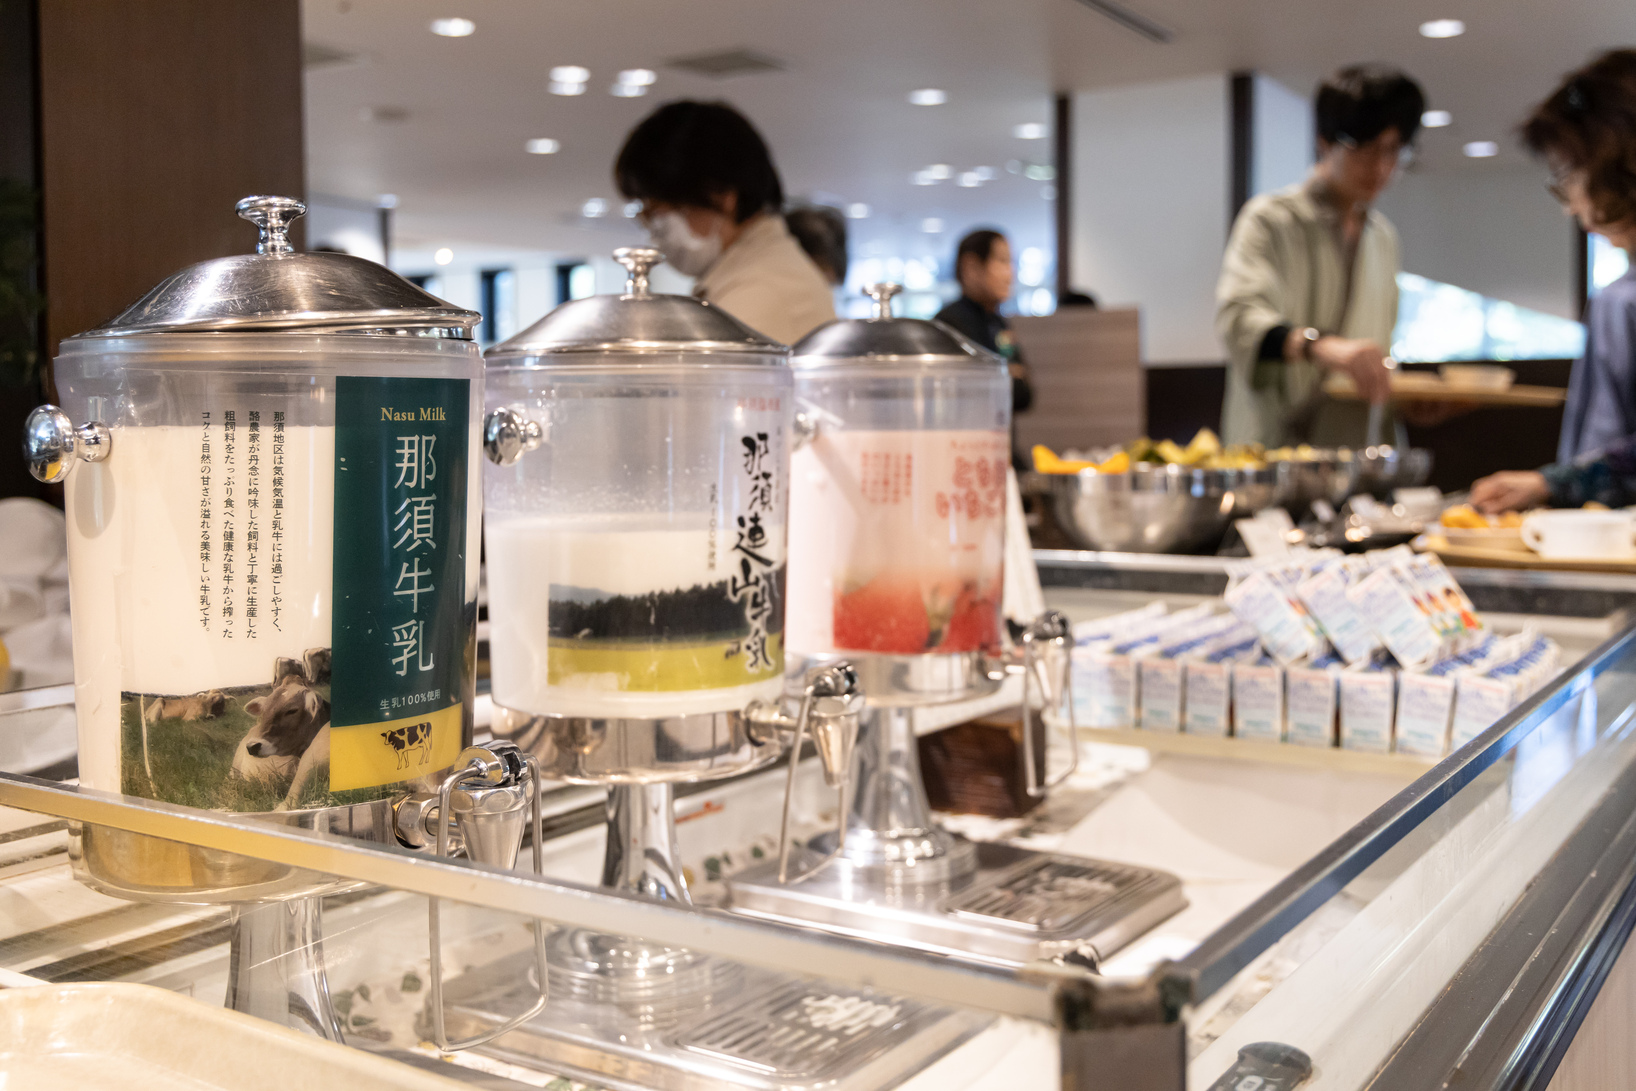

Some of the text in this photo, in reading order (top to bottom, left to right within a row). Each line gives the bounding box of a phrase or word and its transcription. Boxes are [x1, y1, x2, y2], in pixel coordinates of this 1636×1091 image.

[200, 411, 212, 632] コクと自然の甘さが溢れる美味しい牛乳です。
[271, 411, 285, 632] 那須地区は気候気温と乳牛には過ごしやすく、
[380, 406, 447, 421] Nasu Milk
[222, 410, 236, 639] 粗飼料をたっぷり食べた健康な乳牛から搾った
[246, 410, 260, 639] 酪農家が丹念に吟味した飼料と丁寧に生産した
[392, 433, 438, 677] 那須牛乳
[380, 689, 441, 710] 生乳100%使用
